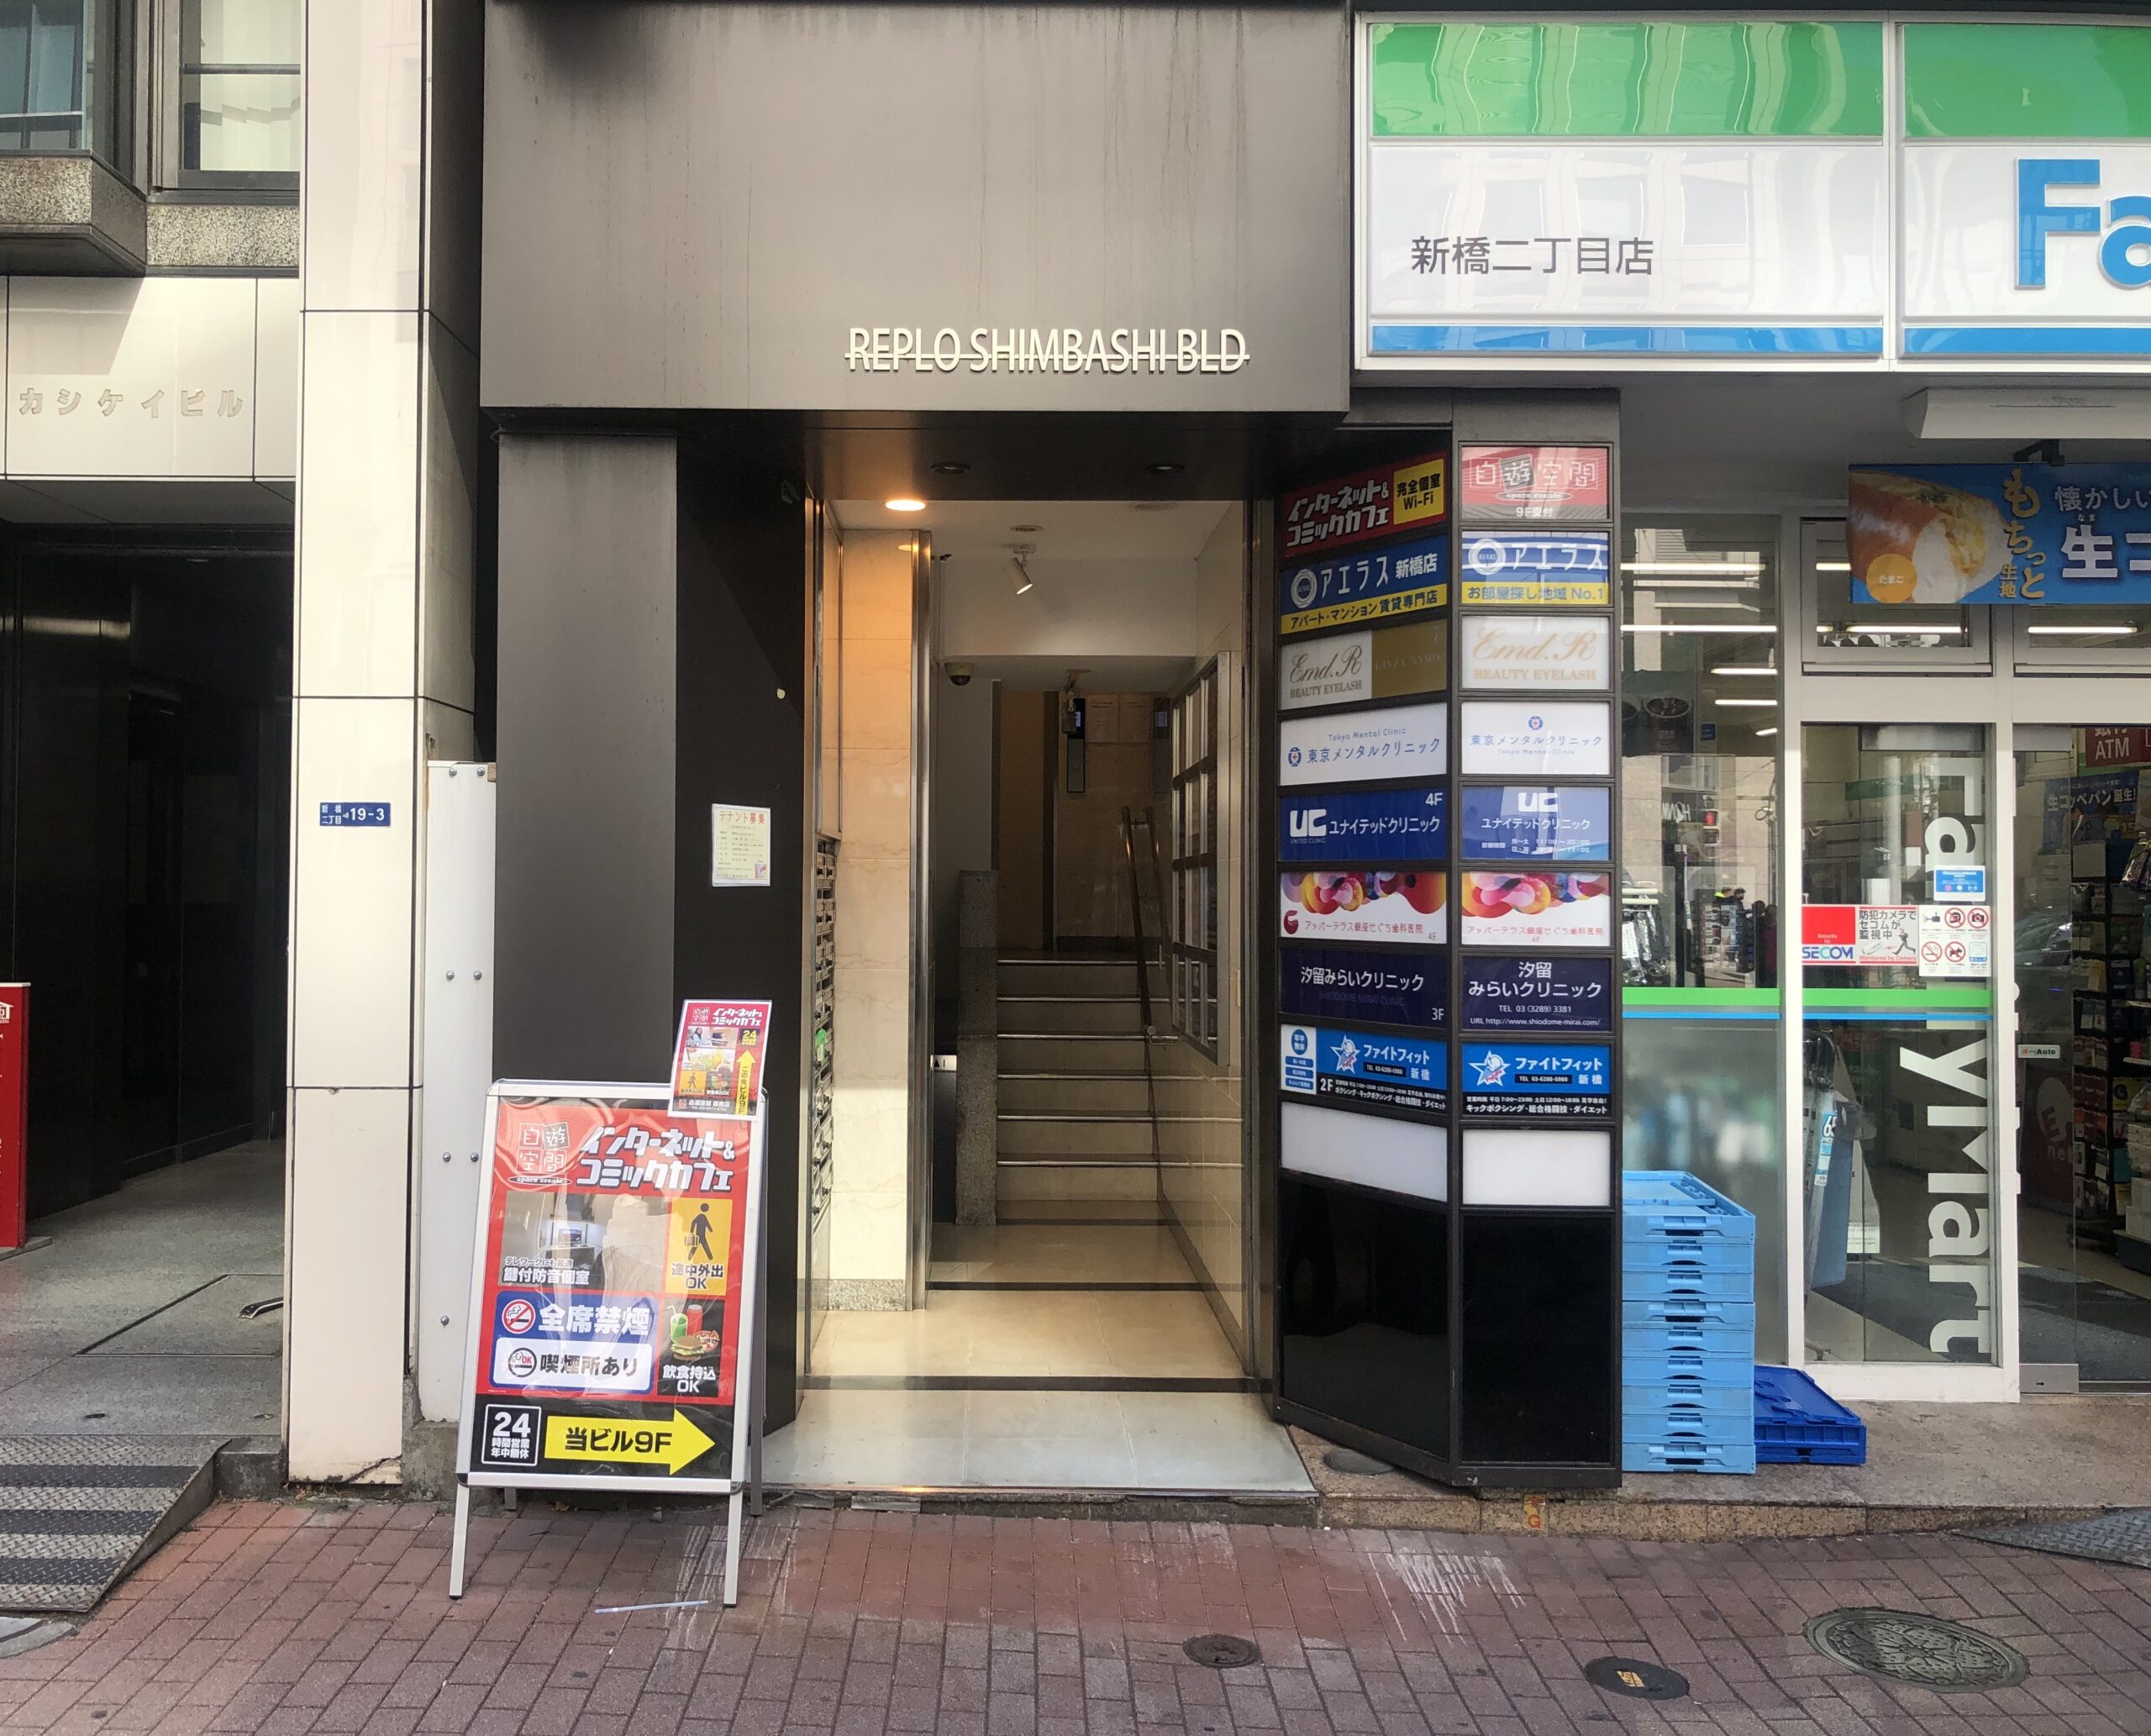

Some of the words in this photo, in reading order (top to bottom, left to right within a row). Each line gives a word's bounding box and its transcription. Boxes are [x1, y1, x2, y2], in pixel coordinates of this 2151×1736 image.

[1410, 234, 1654, 276] 新橋二丁目店
[849, 327, 961, 371] REPLO
[970, 327, 1166, 372] SHIMBASHI
[1177, 328, 1247, 372] BLD
[18, 387, 244, 418] カシケイビル
[1396, 472, 1441, 497] 完全個室
[1287, 479, 1390, 522] インターネット&
[1402, 491, 1433, 511] Wi-Fi
[1515, 506, 1554, 518] 9F受付
[1286, 504, 1390, 547] コミックカフェ
[1511, 544, 1604, 571] アエラス
[1320, 555, 1389, 598] アエラス
[1395, 553, 1438, 580] 新橋店
[1878, 575, 1905, 584] たまご
[1999, 564, 2017, 598] 生地
[1570, 587, 1604, 600] No.1
[1474, 669, 1530, 680] BEAUTY
[1533, 669, 1596, 680] EYELASH
[1290, 685, 1323, 698] BEAUTY
[1323, 680, 1362, 695] EYELASH
[1328, 734, 1350, 742] Tokyo
[1353, 729, 1381, 739] Mental
[1382, 728, 1407, 736] Clinic
[1470, 734, 1602, 746] 東京メンタルクリニック
[1307, 738, 1440, 764] 東京メンタルクリニック
[2095, 737, 2130, 760] ATM
[1425, 792, 1444, 806] 4F
[1517, 792, 1559, 813] UC
[321, 815, 342, 824] 二丁目
[350, 808, 385, 821] 19-3
[719, 810, 765, 825] テナント募集
[1290, 808, 1327, 838] UC
[1328, 815, 1441, 834] ユナイテッドクリニック
[1480, 818, 1591, 830] ユナイテッドクリニック
[1859, 910, 1917, 920] 防犯カメラで
[1859, 920, 1901, 930] セコムが
[1427, 932, 1438, 941] 4F
[1859, 929, 1893, 940] 監視中
[1801, 946, 1854, 960] SECOM
[1517, 961, 1553, 979] 汐留
[1300, 966, 1425, 992] 汐留みらいクリニック
[1467, 981, 1602, 998] みらいクリニック
[1431, 1007, 1445, 1021] 3F
[743, 1029, 757, 1039] 24
[1363, 1044, 1430, 1065] ファイトフィット
[1514, 1056, 1603, 1071] ファイトフィット
[1410, 1067, 1431, 1081] 新橋
[1578, 1074, 1603, 1086] 新橋
[1319, 1077, 1334, 1092] 2F
[576, 1158, 734, 1191] コミックカフェ
[505, 1256, 574, 1268] テレワークにも最適
[502, 1266, 591, 1286] 鍵付防音個室
[671, 1263, 724, 1278] 途中外出
[684, 1276, 707, 1290] OK
[537, 1302, 651, 1336] 全席禁煙
[521, 1355, 533, 1365] OK
[539, 1353, 639, 1378] 喫煙所あり
[662, 1364, 717, 1382] 飲食持込
[676, 1379, 701, 1393] OK
[492, 1411, 532, 1439] 24
[492, 1437, 531, 1449] 時間営業
[565, 1426, 673, 1454] 当ビル9F
[491, 1447, 530, 1460] 年中無休
